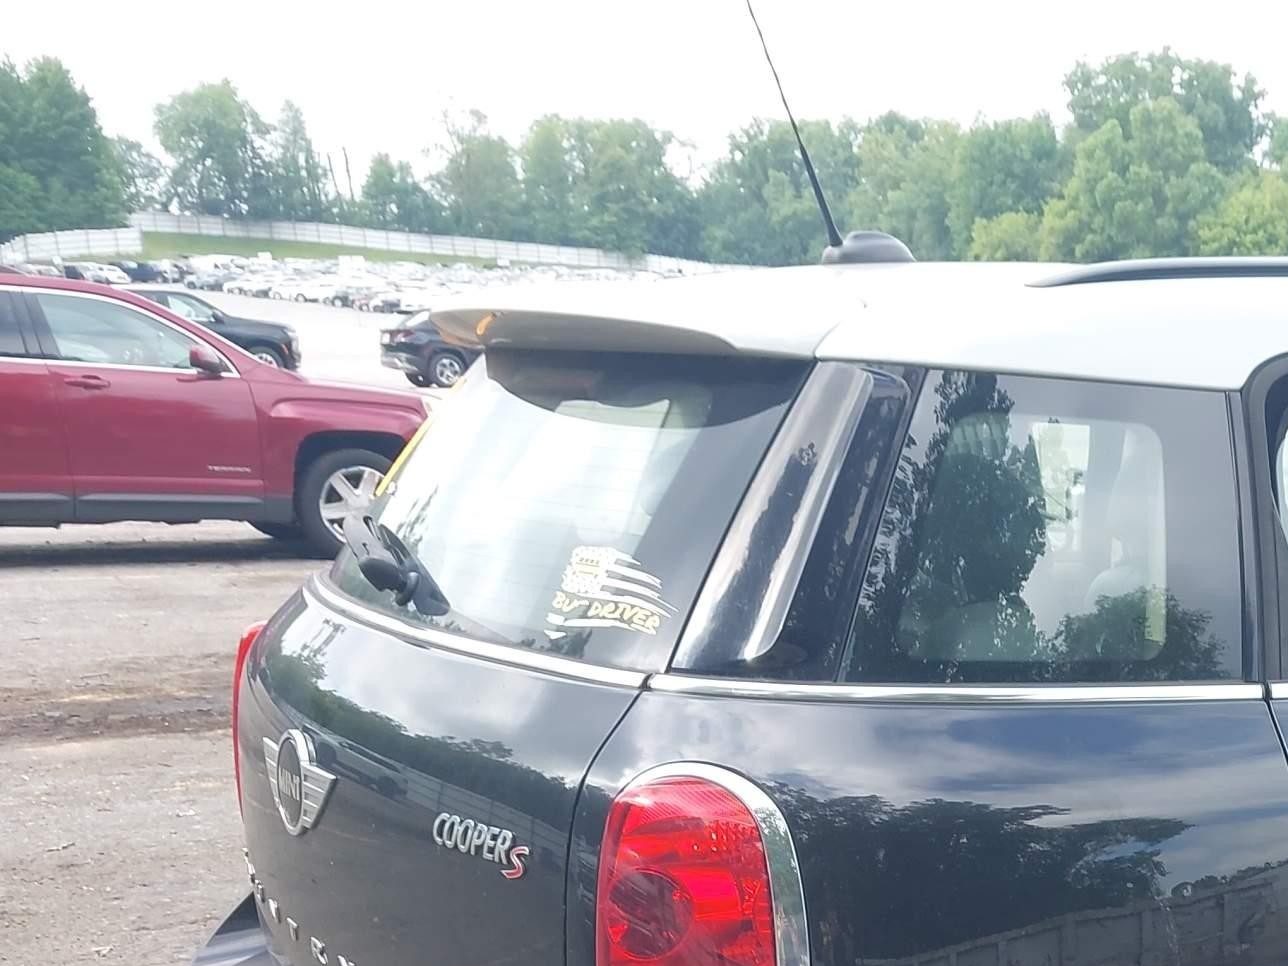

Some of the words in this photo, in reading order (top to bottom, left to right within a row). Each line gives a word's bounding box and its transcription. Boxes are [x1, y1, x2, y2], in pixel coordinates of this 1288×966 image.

[587, 601, 660, 635] DRIVER
[278, 767, 301, 801] MINI
[432, 812, 513, 865] COOPER
[500, 845, 530, 880] S
